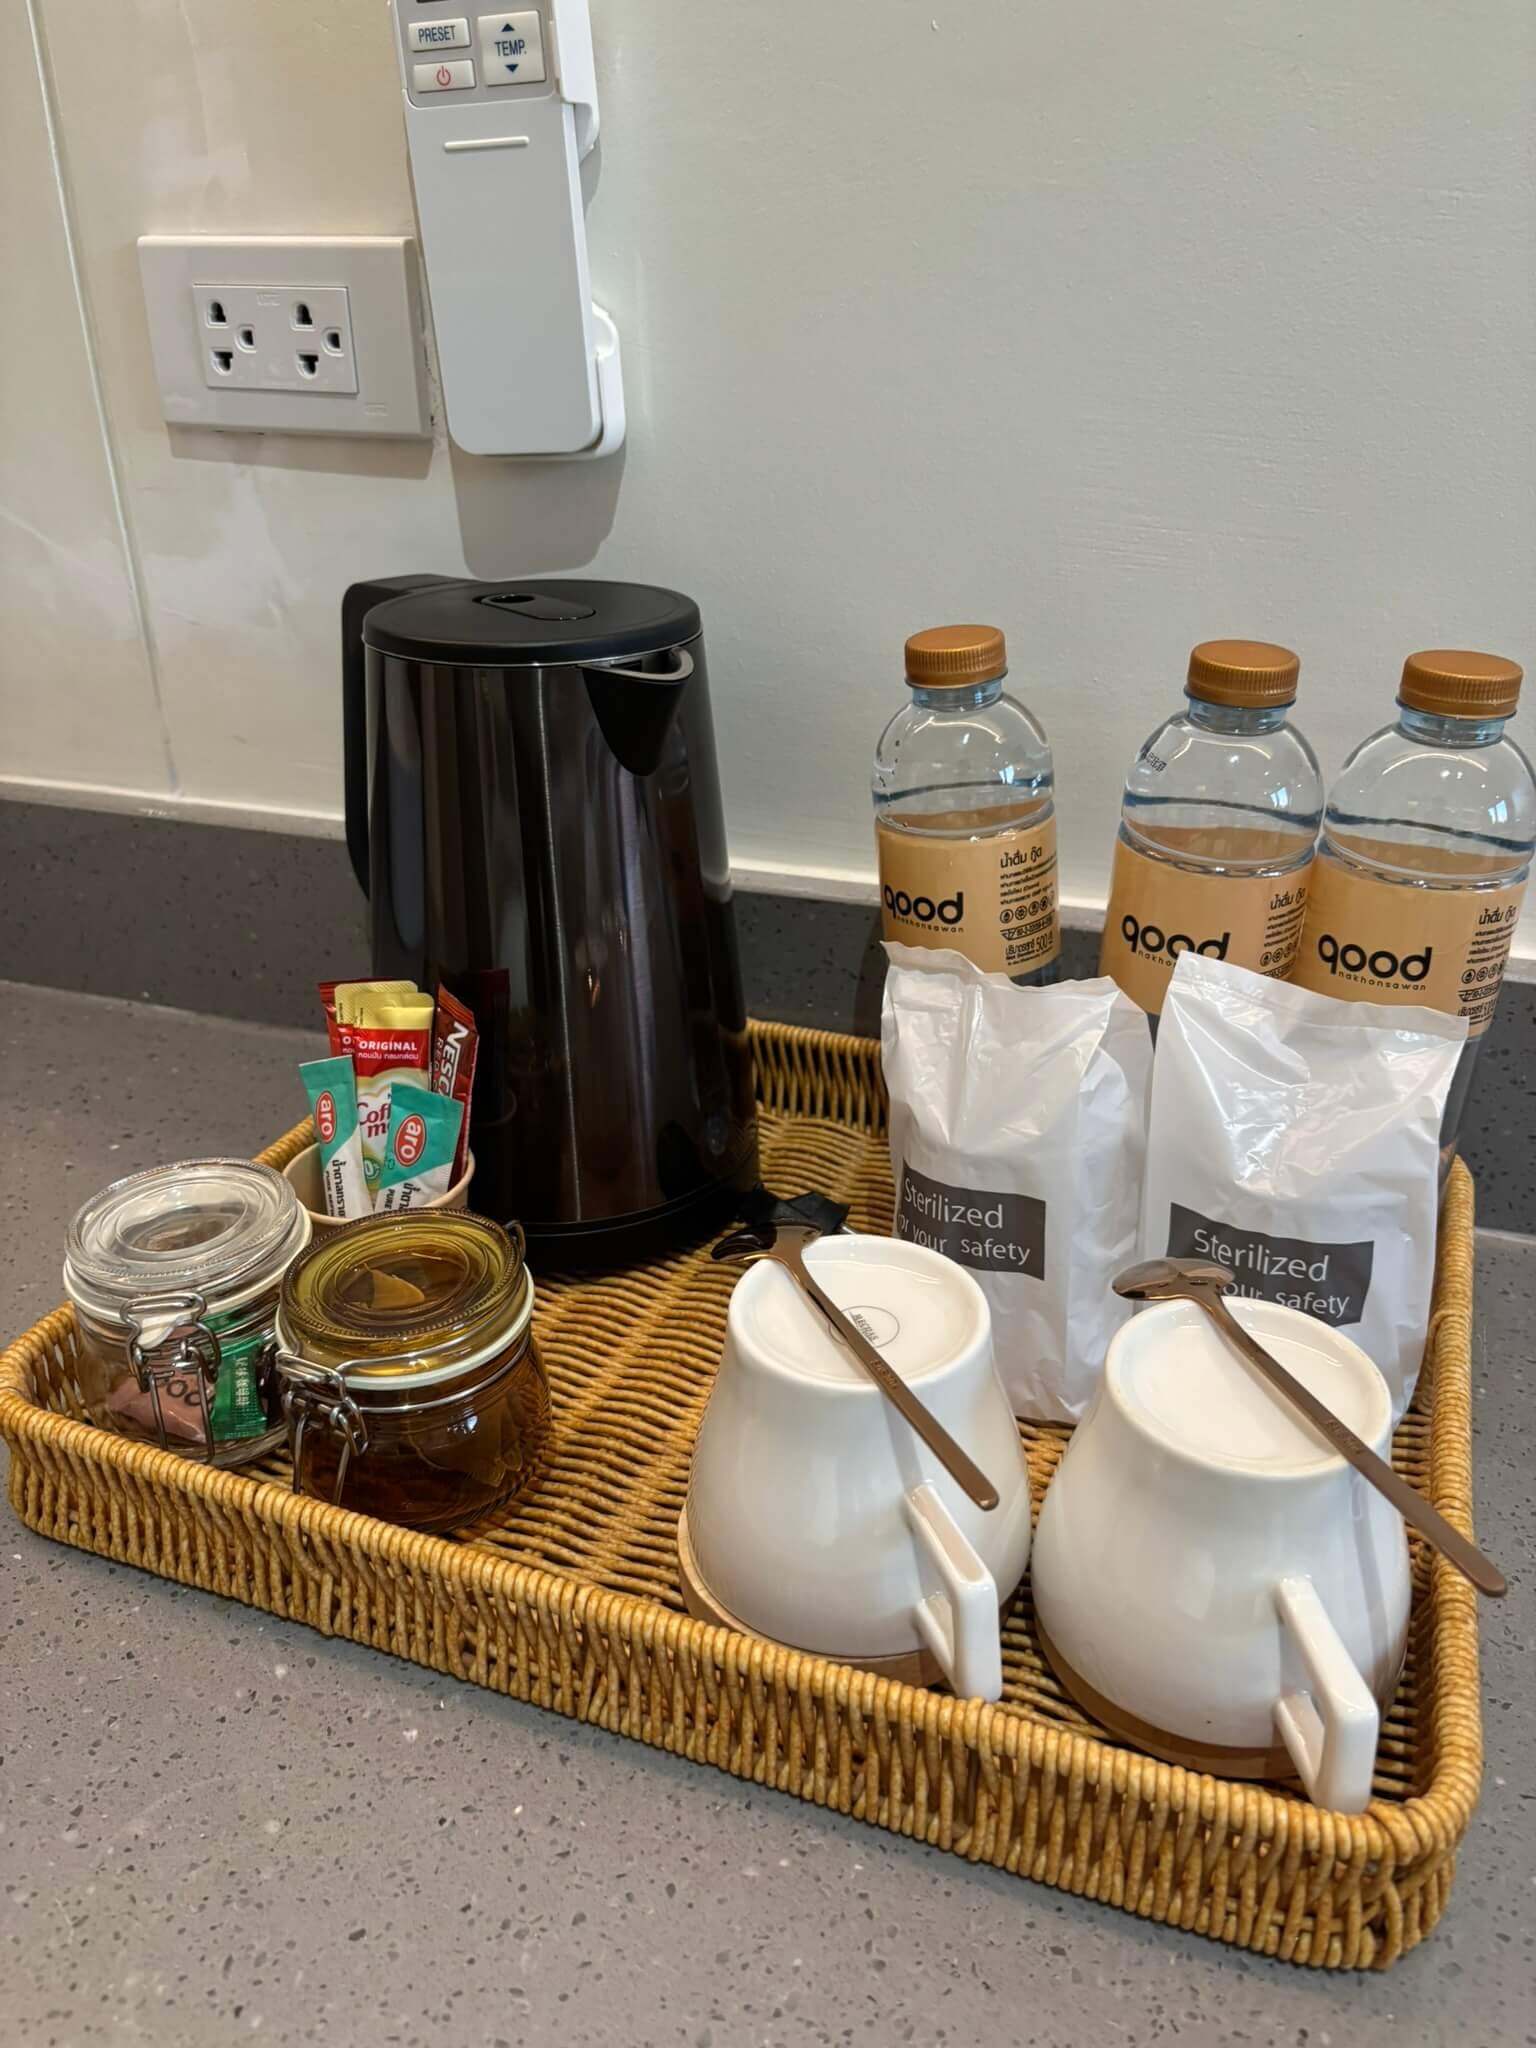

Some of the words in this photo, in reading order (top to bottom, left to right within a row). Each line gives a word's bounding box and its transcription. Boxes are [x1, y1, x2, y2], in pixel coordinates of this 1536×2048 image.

[418, 25, 456, 43] PRESET
[494, 39, 527, 57] TEMP.
[884, 884, 964, 925] qood
[1318, 933, 1433, 982] qood
[1338, 970, 1427, 991] nakhonsawan
[359, 1040, 418, 1051] ORIGINAL
[438, 1021, 469, 1099] NESC
[320, 1099, 333, 1136] aro
[400, 1121, 421, 1159] aro
[384, 1188, 396, 1209] PURE
[904, 1177, 1003, 1229] Sterilized
[912, 1224, 948, 1253] your
[961, 1238, 1031, 1266] safety
[1194, 1228, 1330, 1282] Sterilized
[1223, 1282, 1263, 1300] our
[1275, 1291, 1350, 1318] safety
